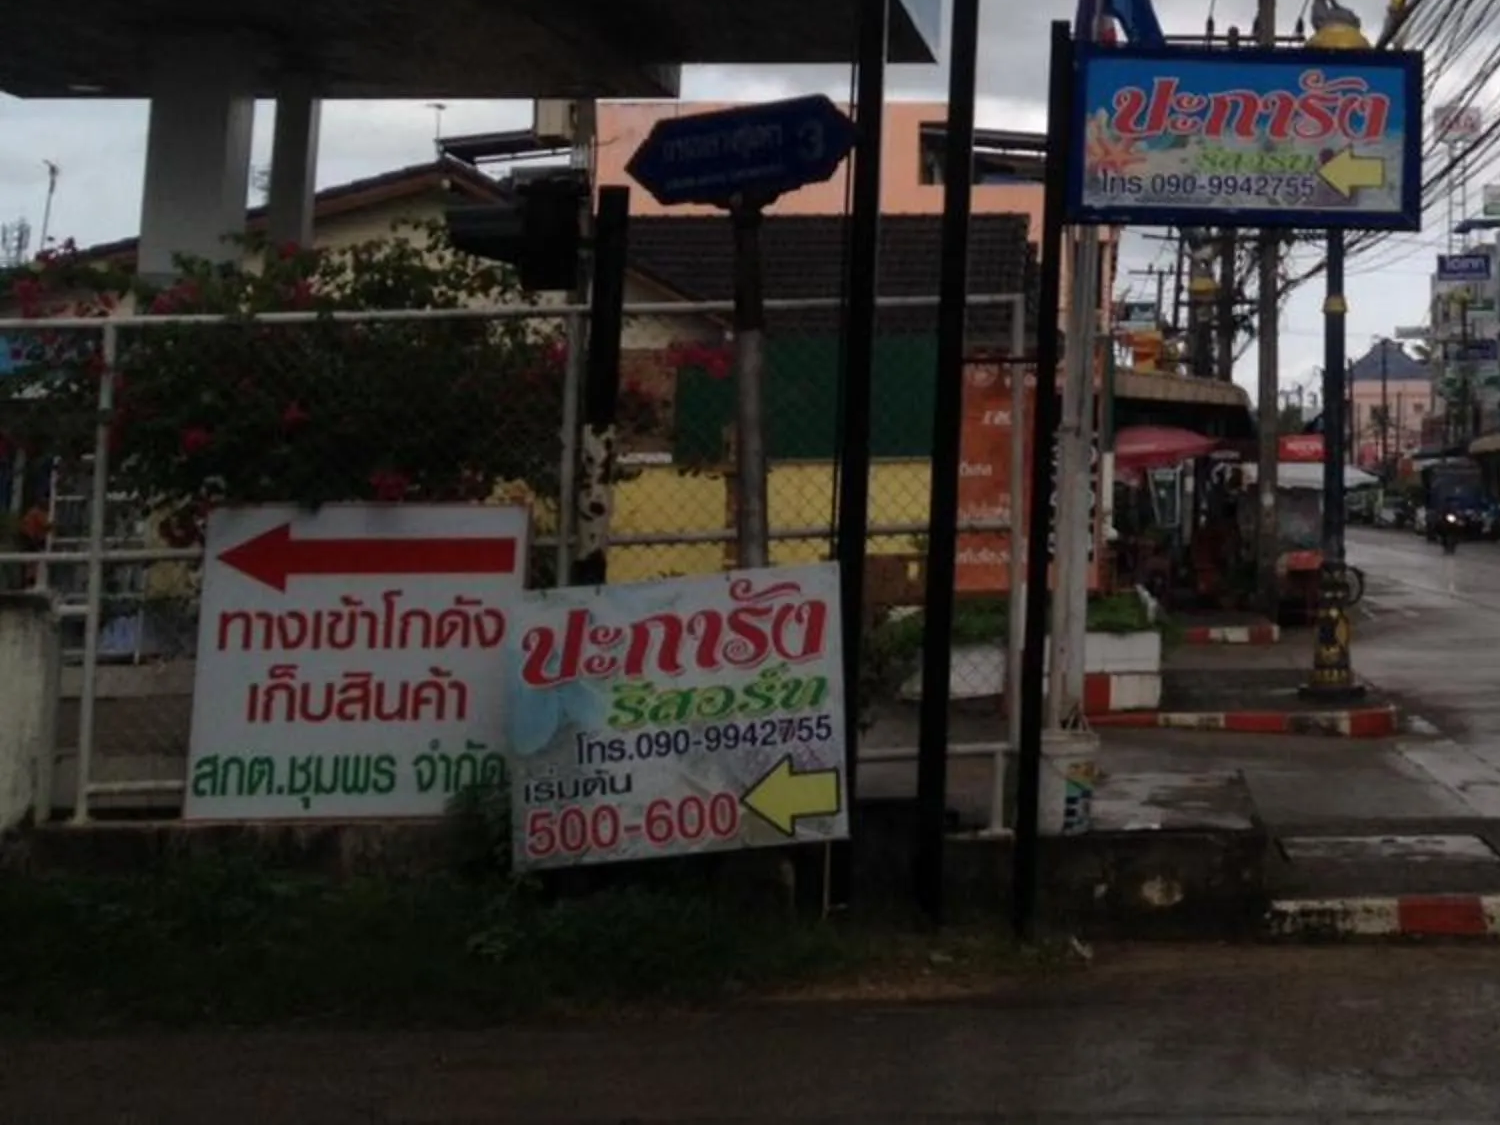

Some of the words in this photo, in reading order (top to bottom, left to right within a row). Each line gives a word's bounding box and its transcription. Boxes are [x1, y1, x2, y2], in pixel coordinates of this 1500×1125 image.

[1151, 174, 1316, 198] 090-9942755
[217, 590, 507, 652] ทางเข้าโกดัง
[246, 664, 468, 723] เก็บสินค้า
[608, 662, 828, 728] รีสอร์ท
[191, 754, 397, 810] สกต.ชุมพร
[526, 793, 740, 857] 500-600
